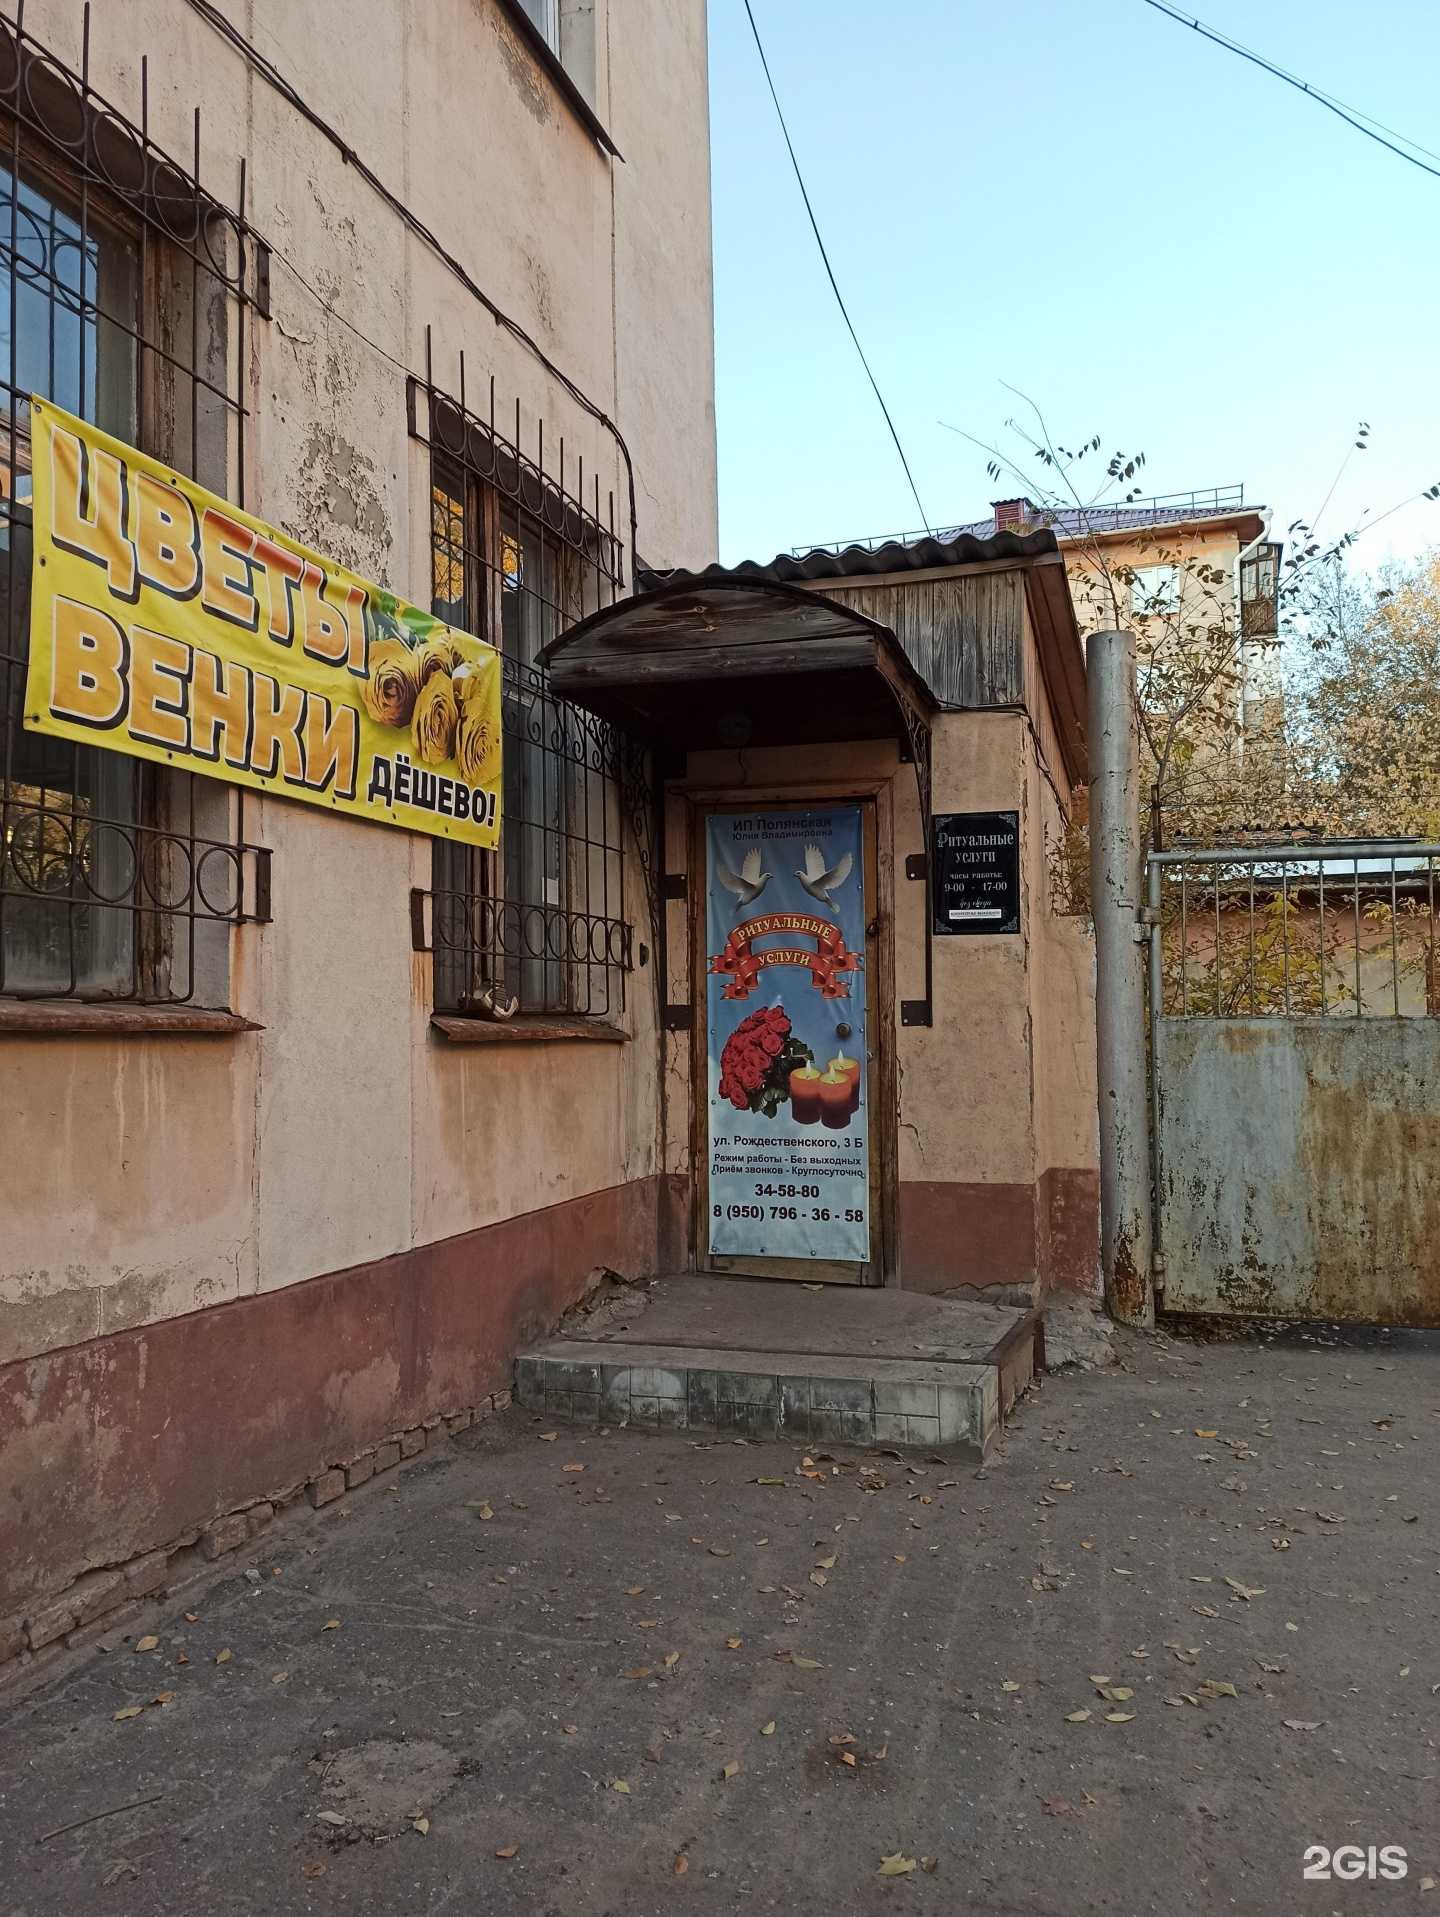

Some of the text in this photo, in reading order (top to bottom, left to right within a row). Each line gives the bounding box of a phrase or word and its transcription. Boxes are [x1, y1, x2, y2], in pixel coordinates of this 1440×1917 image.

[50, 425, 371, 680] ЦВЕТЫ
[48, 595, 360, 801] ВЕНКИ
[368, 752, 497, 827] ДЁШЕВО!
[733, 817, 833, 832] ИП Полянская
[732, 829, 833, 841] Юлия Владимировна
[937, 832, 1015, 848] Ритуальные
[944, 882, 965, 892] 9-00
[983, 881, 1008, 891] 17-00
[737, 917, 832, 941] РИТУАЛЬНЫЕ
[759, 951, 810, 966] УСЛУГИ
[713, 1136, 863, 1149] ул. Рождественского, 3 Б
[714, 1154, 745, 1162] Режим
[747, 1155, 782, 1164] работы
[790, 1155, 807, 1164] Без
[810, 1157, 862, 1166] выходных
[713, 1165, 743, 1174] Приём
[745, 1166, 783, 1175] звонков
[791, 1167, 863, 1177] Круглосуточно
[754, 1183, 820, 1198] 34-58-80
[713, 1205, 722, 1217] 8
[726, 1205, 765, 1222] (950)
[769, 1206, 797, 1220] 796
[811, 1208, 830, 1221] 36
[844, 1210, 864, 1222] 58
